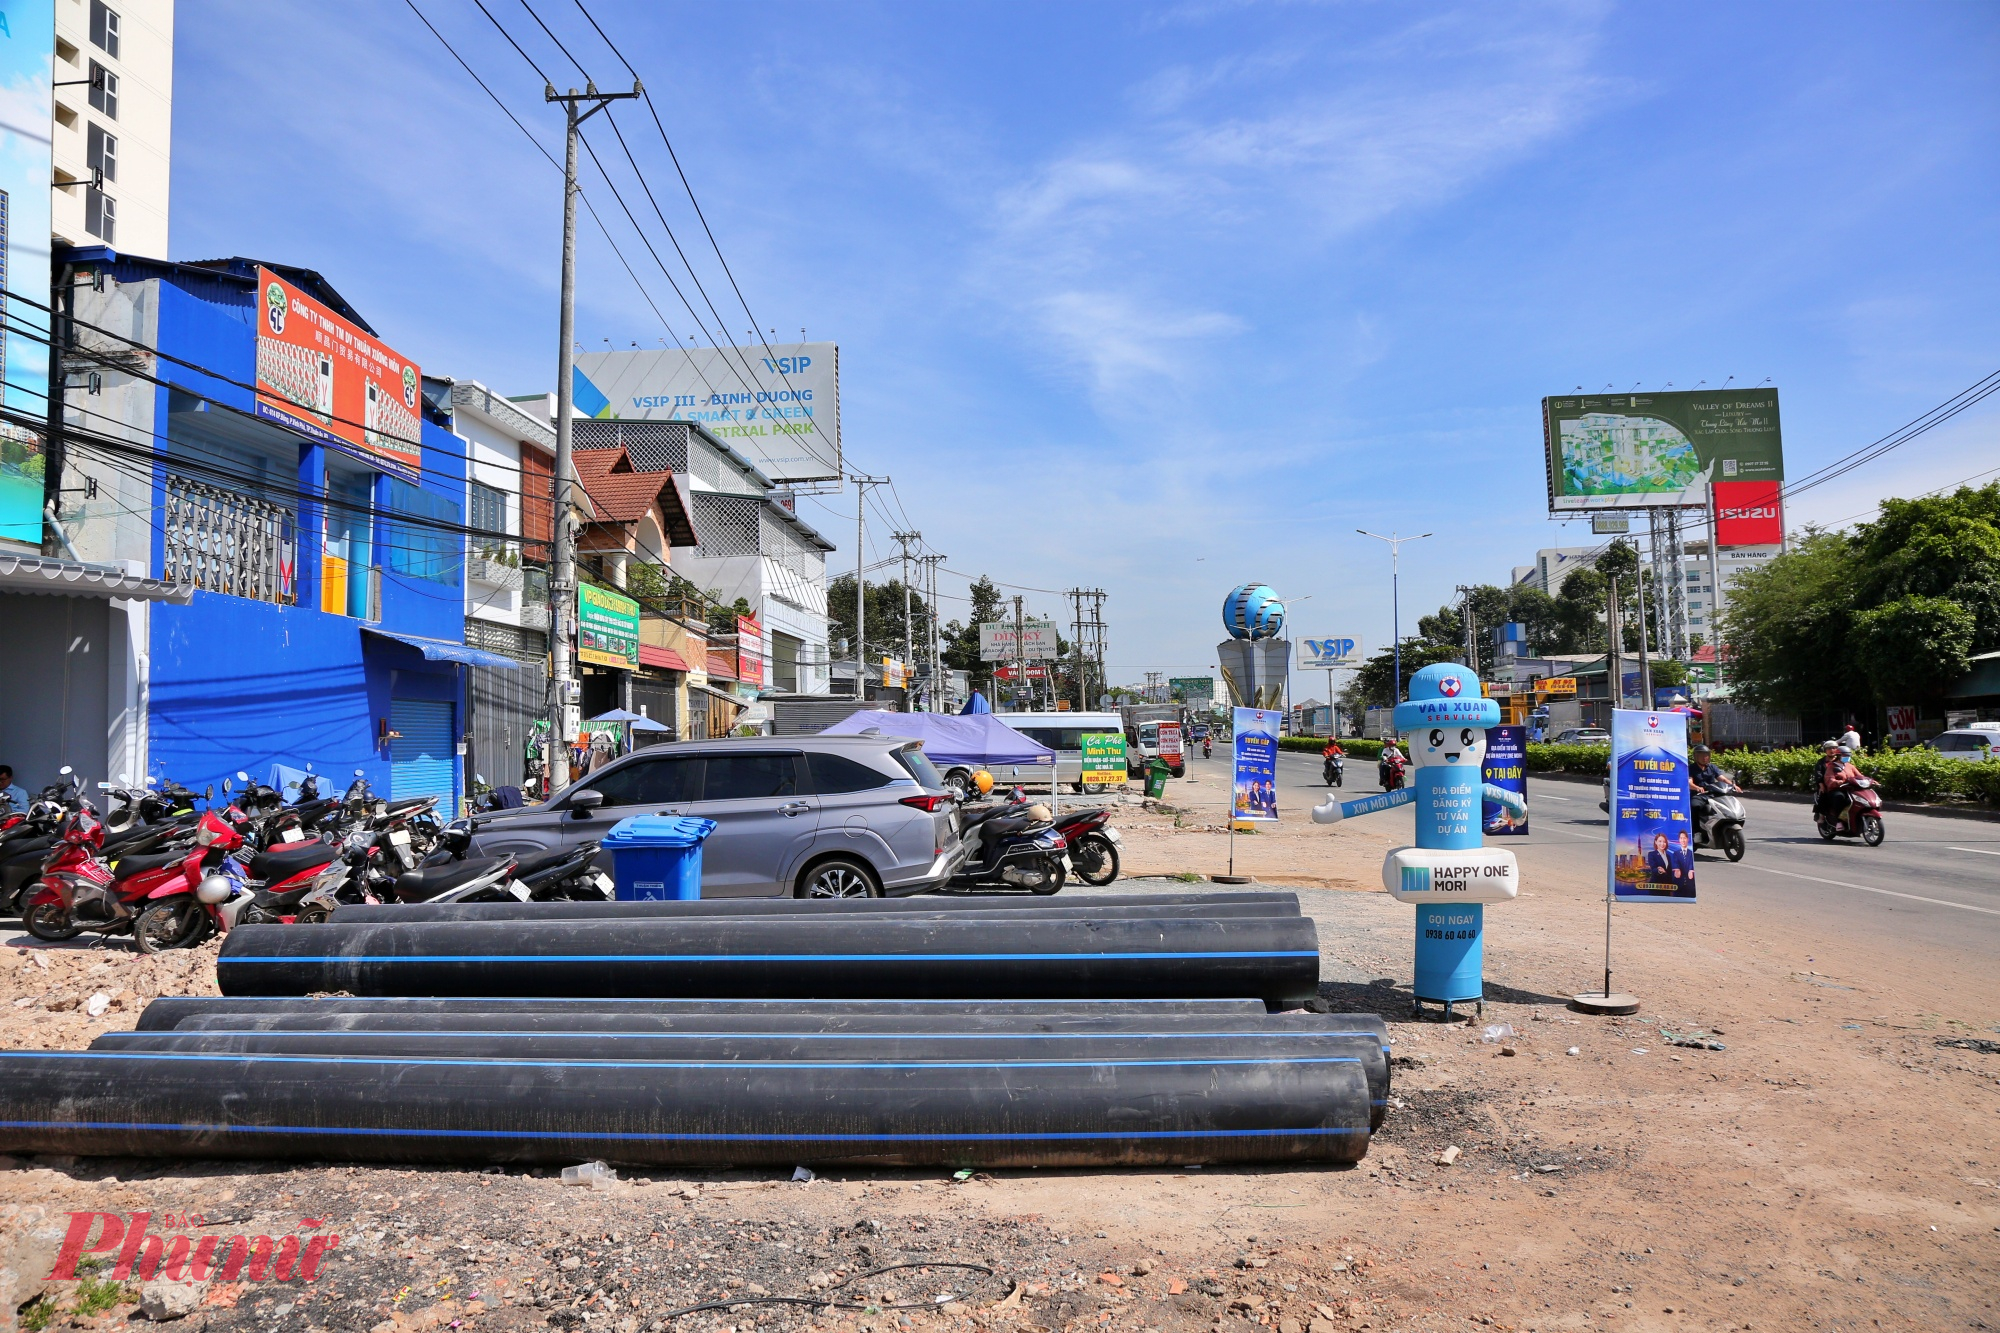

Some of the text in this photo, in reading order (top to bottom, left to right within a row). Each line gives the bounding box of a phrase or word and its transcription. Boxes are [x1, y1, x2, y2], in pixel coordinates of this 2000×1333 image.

[291, 298, 309, 320] CÔNG
[309, 309, 318, 325] TY
[318, 314, 335, 335] TNHH
[335, 324, 345, 340] TM
[344, 330, 353, 346] DV
[388, 354, 400, 375] MÔN
[759, 356, 812, 375] VSIP
[632, 396, 670, 409] VSIP
[674, 395, 696, 407] III
[711, 392, 751, 406] BINH
[756, 389, 814, 403] DUONG
[1692, 403, 1720, 411] VALLEY
[1735, 401, 1765, 409] DREAMS
[693, 409, 741, 422] SMART
[745, 409, 756, 420] &
[761, 405, 814, 420] GREEN
[772, 423, 814, 436] PARK
[758, 456, 814, 464] www.vsip.com.vn
[1719, 507, 1776, 519] ISUZU
[1303, 638, 1355, 658] VSIP
[1419, 702, 1488, 714] VAN XUAN
[1427, 713, 1481, 722] SERVICE
[1086, 747, 1105, 755] Minh
[1106, 747, 1122, 755] Thu
[1660, 758, 1676, 772] GẤP
[1493, 765, 1522, 781] TẠI ĐÂY
[1432, 782, 1472, 797] ĐỊA ĐIỂM
[1485, 786, 1502, 799] VXS
[1352, 790, 1408, 816] XIN MỜI VÀO
[1432, 796, 1472, 808] ĐĂNG KÝ
[1435, 810, 1469, 821] TƯ VẤN
[1437, 822, 1467, 835] DỰ ÁN
[1434, 865, 1509, 879] HAPPY ONE
[1434, 880, 1467, 892] MORI
[1428, 914, 1475, 927] GỌI NGAY
[1425, 929, 1476, 940] 0938 60 40 60
